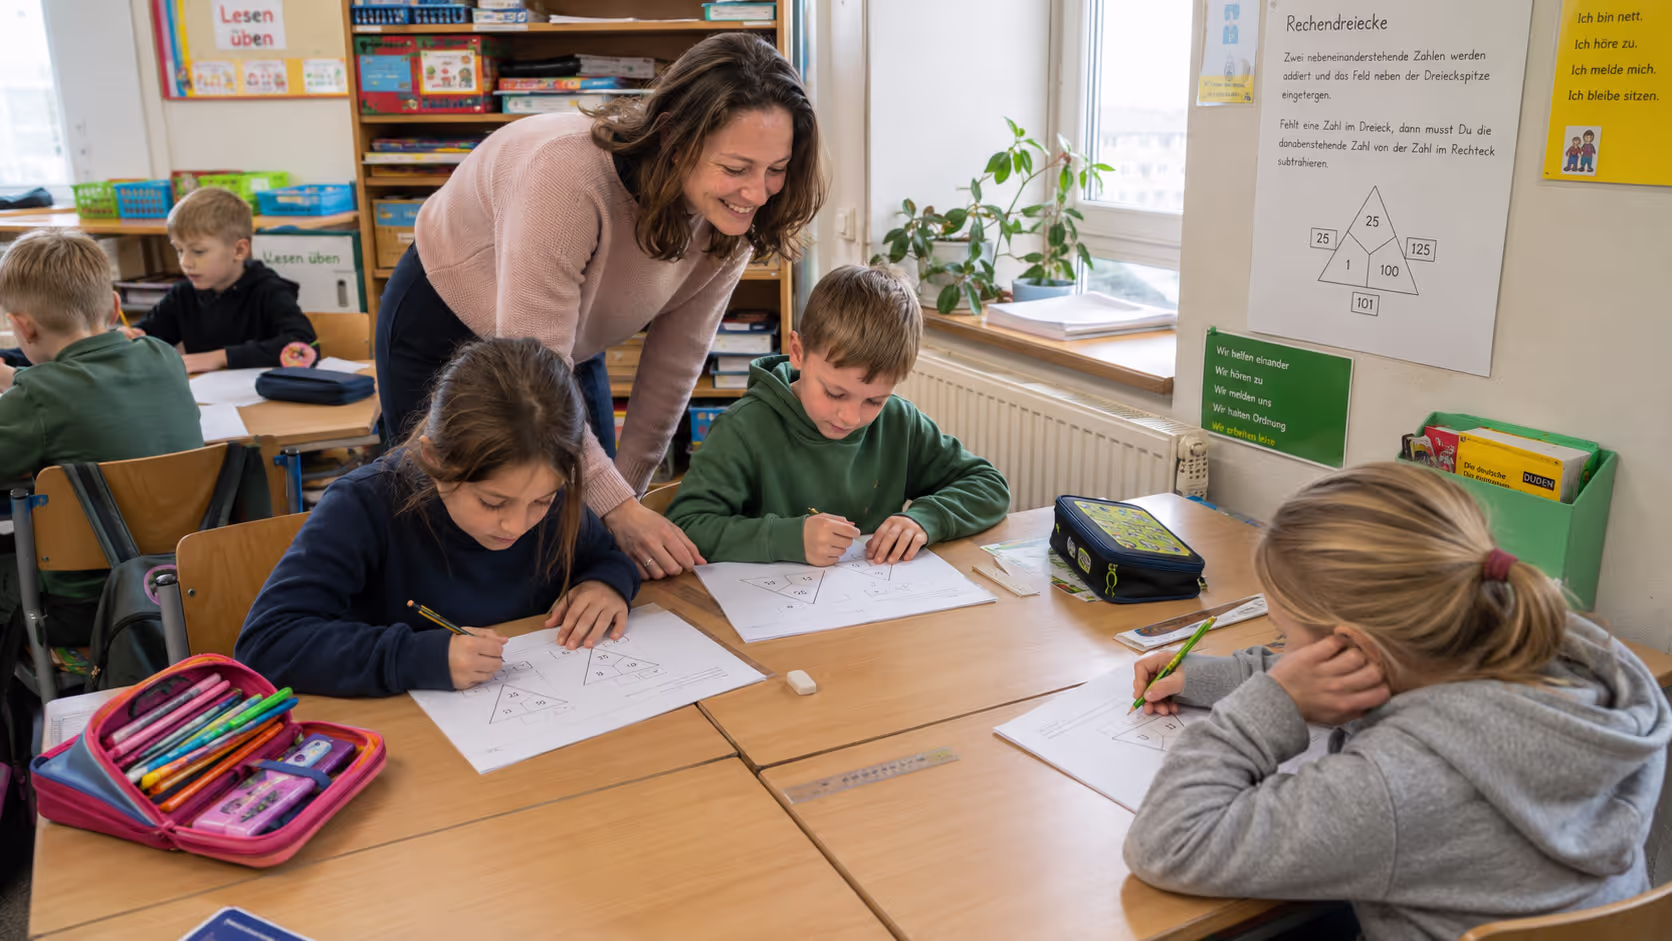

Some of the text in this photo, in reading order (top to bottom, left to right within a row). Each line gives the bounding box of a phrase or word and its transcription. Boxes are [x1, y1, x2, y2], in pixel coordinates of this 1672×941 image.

[220, 4, 274, 24] Lesen
[1577, 11, 1643, 23] Ich bin nett.
[1286, 13, 1388, 32] Rechendreiecke
[231, 28, 274, 47] üben
[1574, 37, 1638, 49] Ich höre zu.
[1284, 49, 1486, 63] Zwei nebeneinanderstehende Zahlen werden
[1571, 63, 1656, 75] Ich melde mich.
[1283, 69, 1490, 84] addiert und das Feld neben der Dreieckspitze
[1282, 89, 1332, 103] eingetergen.
[1568, 90, 1660, 101] Ich bleibe sitzen.
[1279, 118, 1492, 136] Fehlt eine Zahl im Dreieck, dann musst Du die
[1351, 140, 1370, 152] Zahl
[1374, 143, 1389, 152] von
[1393, 141, 1408, 153] der
[1411, 142, 1432, 154] Zahl
[1436, 144, 1447, 154] im
[1451, 144, 1495, 157] Rechteck
[1277, 157, 1329, 169] subtrahieren.
[1366, 215, 1380, 228] 25
[1316, 232, 1330, 244] 25
[1411, 243, 1431, 256] 125
[1346, 259, 1350, 270] 1
[1380, 264, 1400, 277] 100
[1357, 297, 1373, 310] 101
[1216, 345, 1289, 370] Wir helfen einander
[1215, 365, 1263, 385] Wir hören zu
[1214, 384, 1272, 408] Wir melden uns
[1212, 403, 1226, 414] Wir
[1523, 472, 1555, 491] DUDEN
